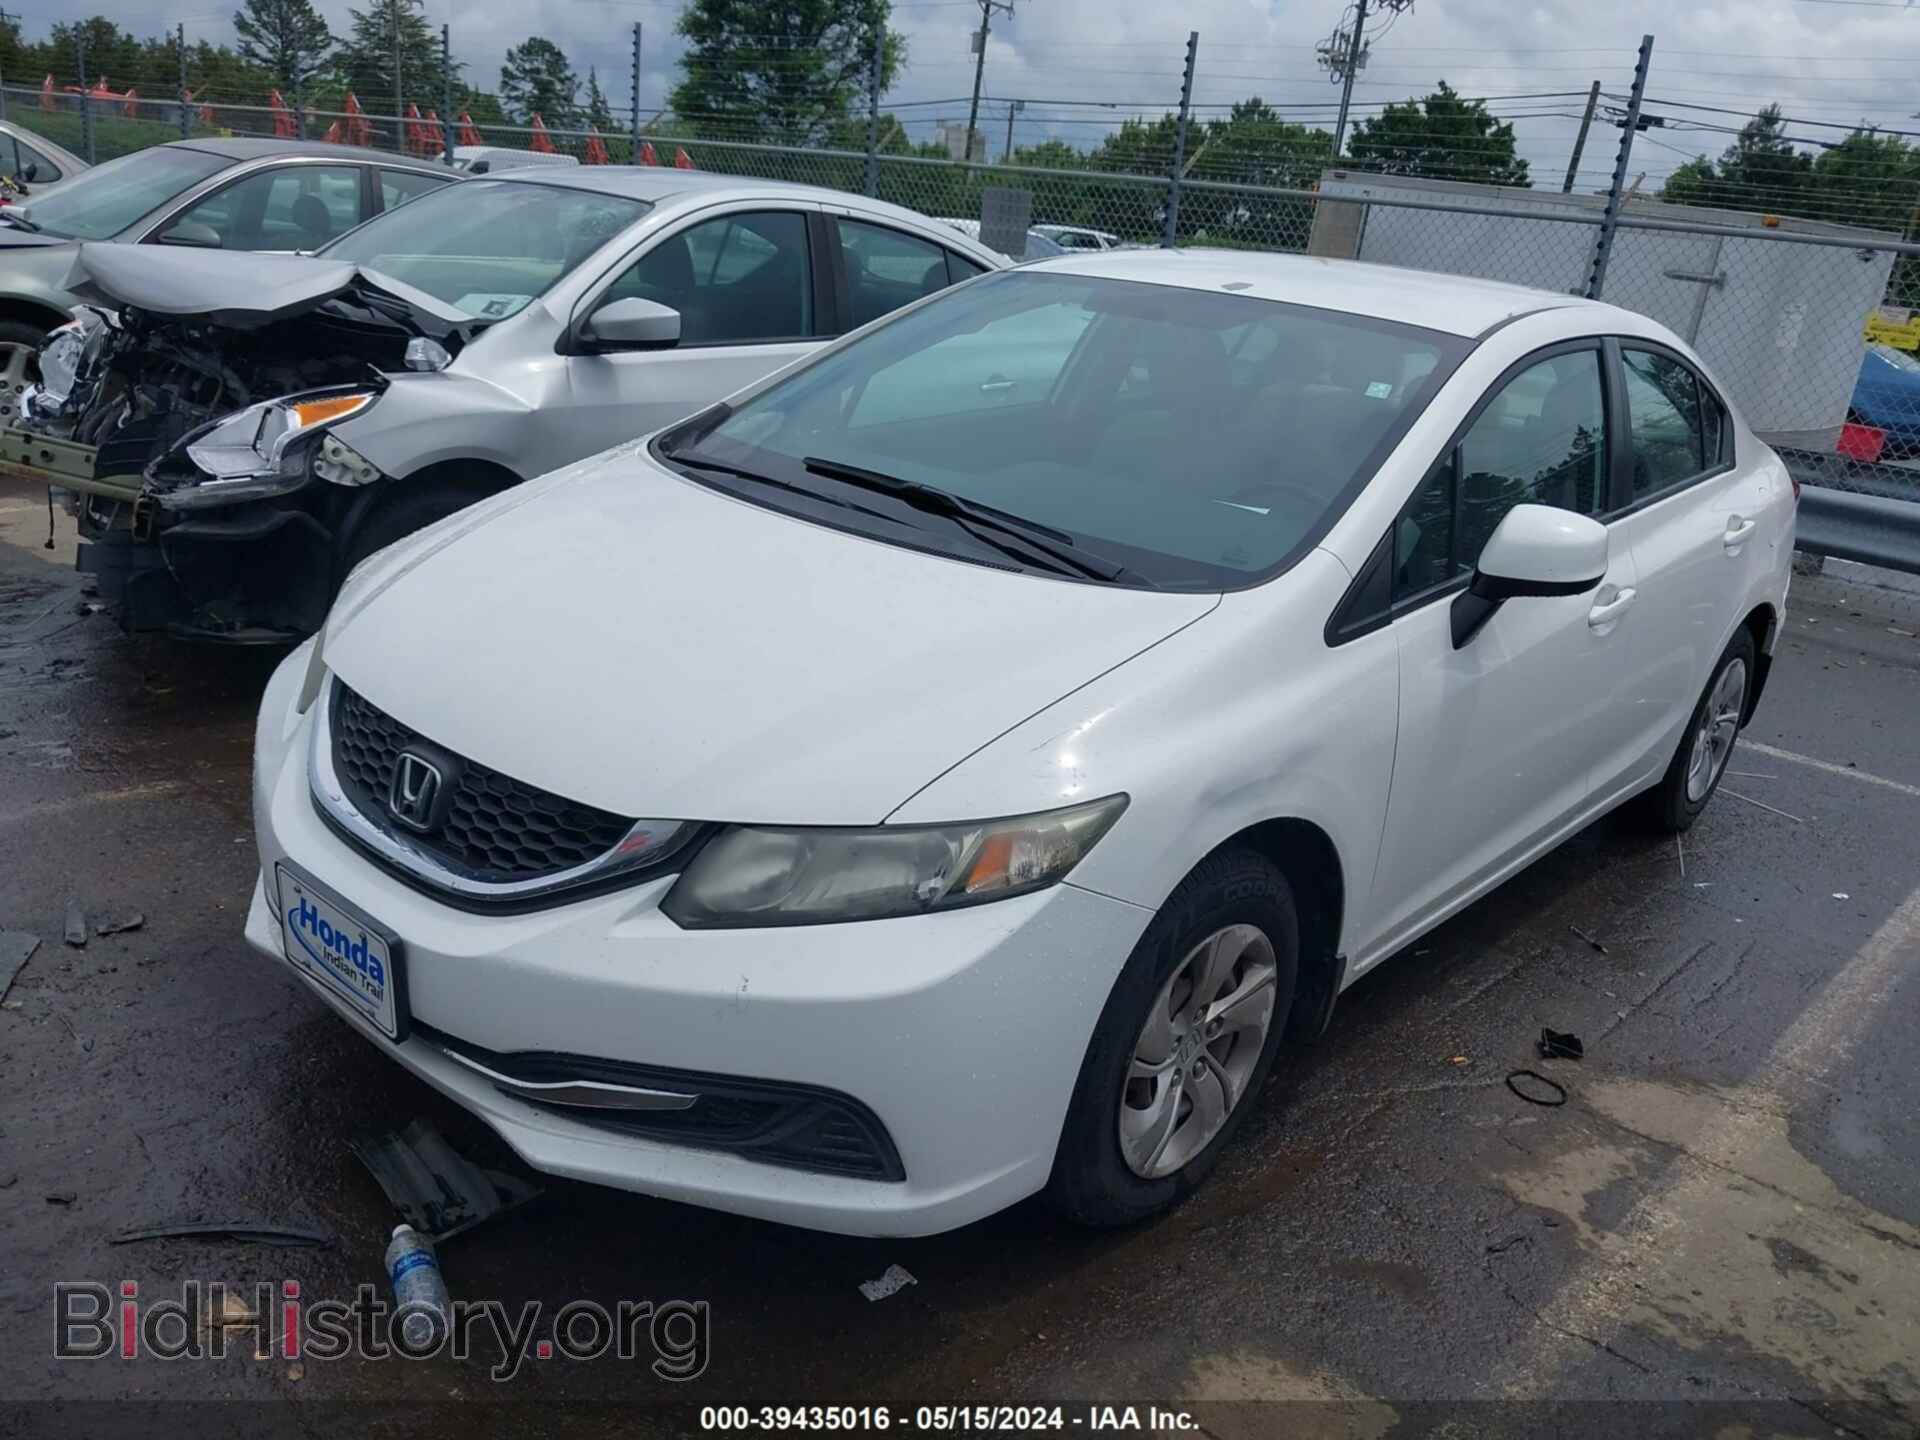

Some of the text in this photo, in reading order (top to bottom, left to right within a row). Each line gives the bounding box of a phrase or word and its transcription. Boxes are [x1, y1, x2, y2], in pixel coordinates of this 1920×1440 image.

[300, 897, 384, 986] Honda
[322, 946, 384, 1000] Indian Trail
